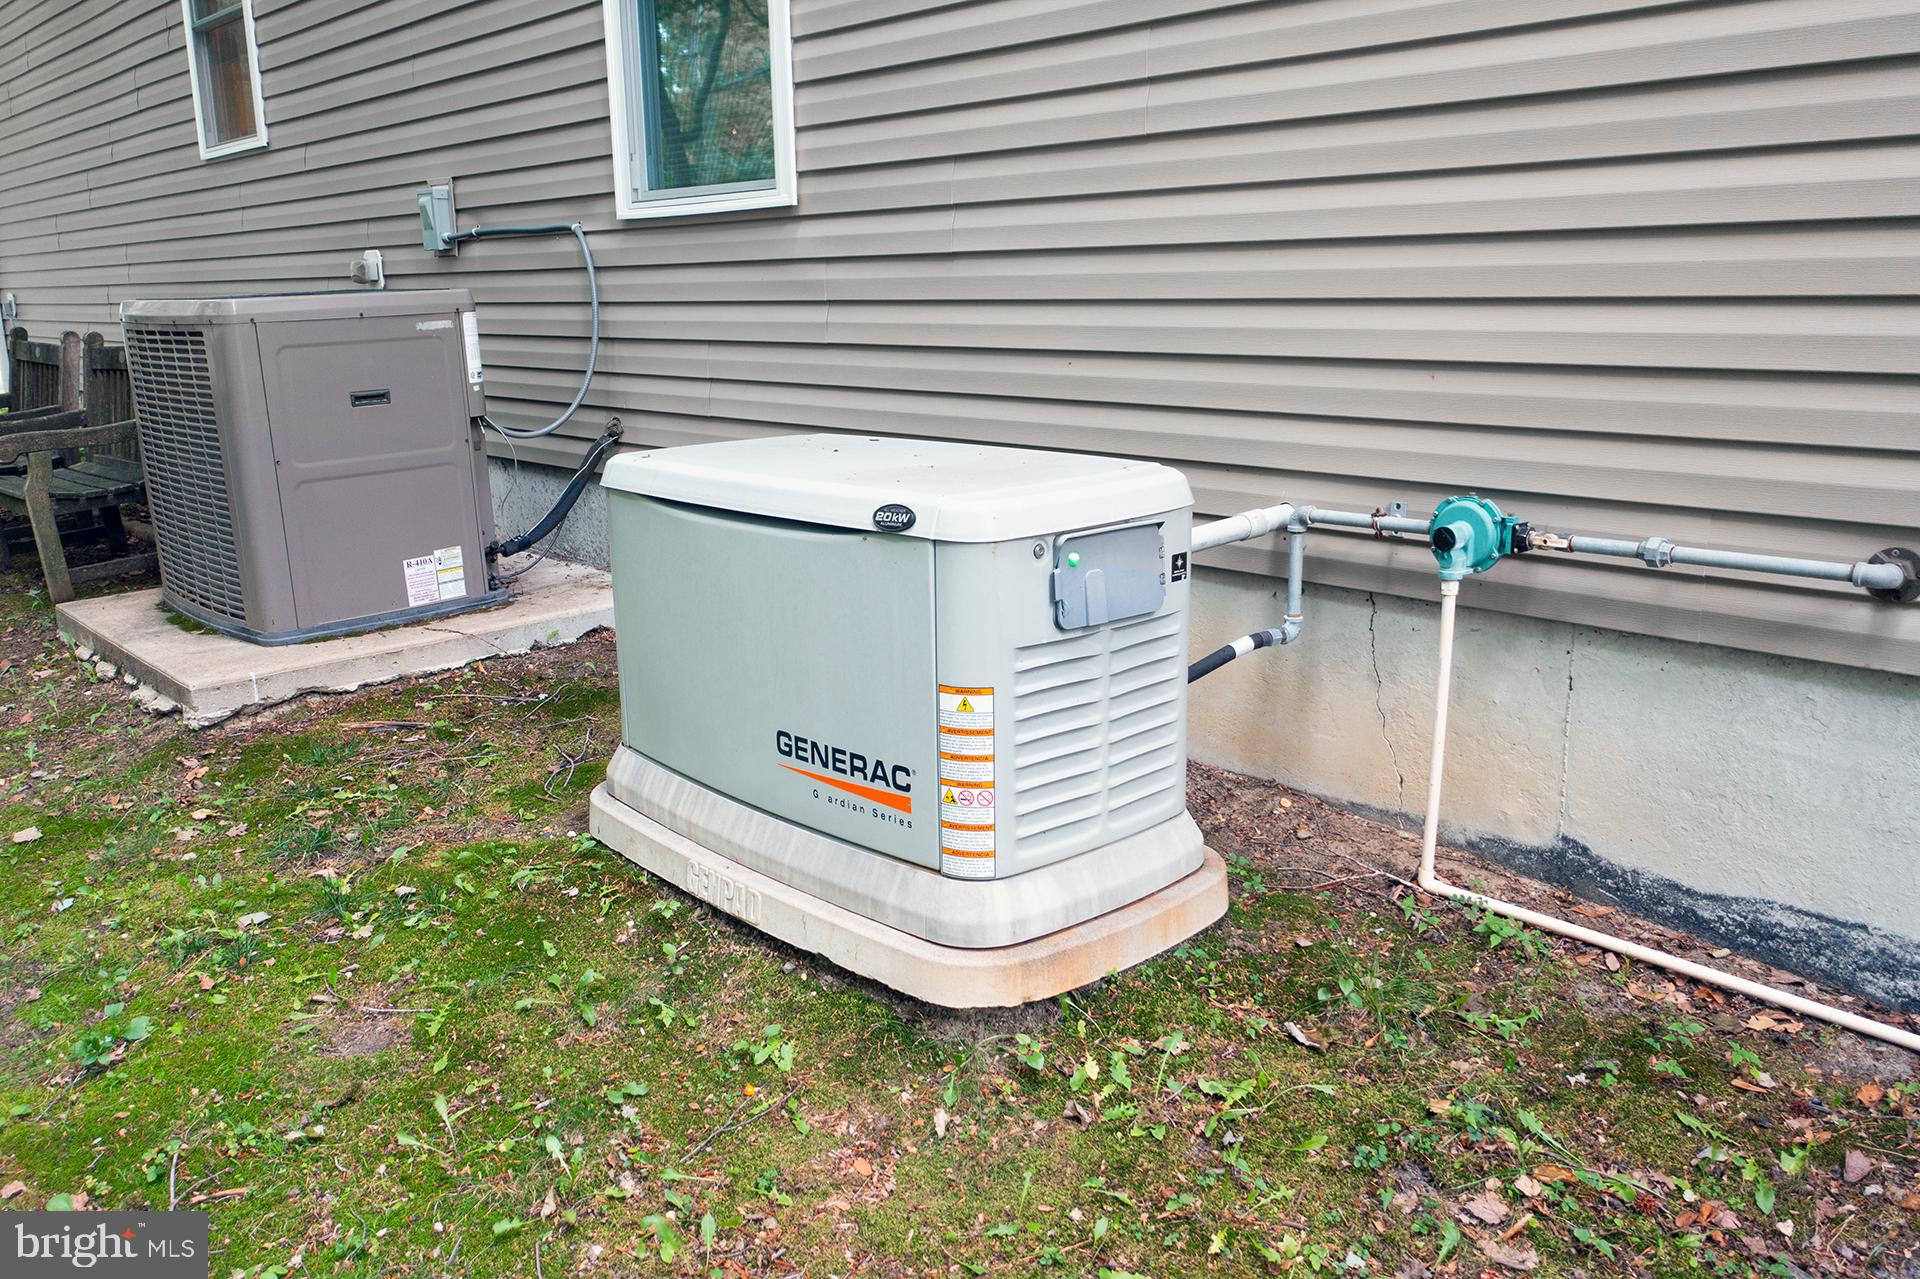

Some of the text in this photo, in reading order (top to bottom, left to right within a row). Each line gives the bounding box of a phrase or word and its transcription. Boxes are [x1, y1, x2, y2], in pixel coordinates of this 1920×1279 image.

[875, 511, 910, 523] 20kW
[406, 557, 433, 569] R-410A
[947, 728, 992, 736] AVERTISSEMENT
[776, 729, 912, 793] GENERAC
[812, 788, 913, 829] Gardian Series
